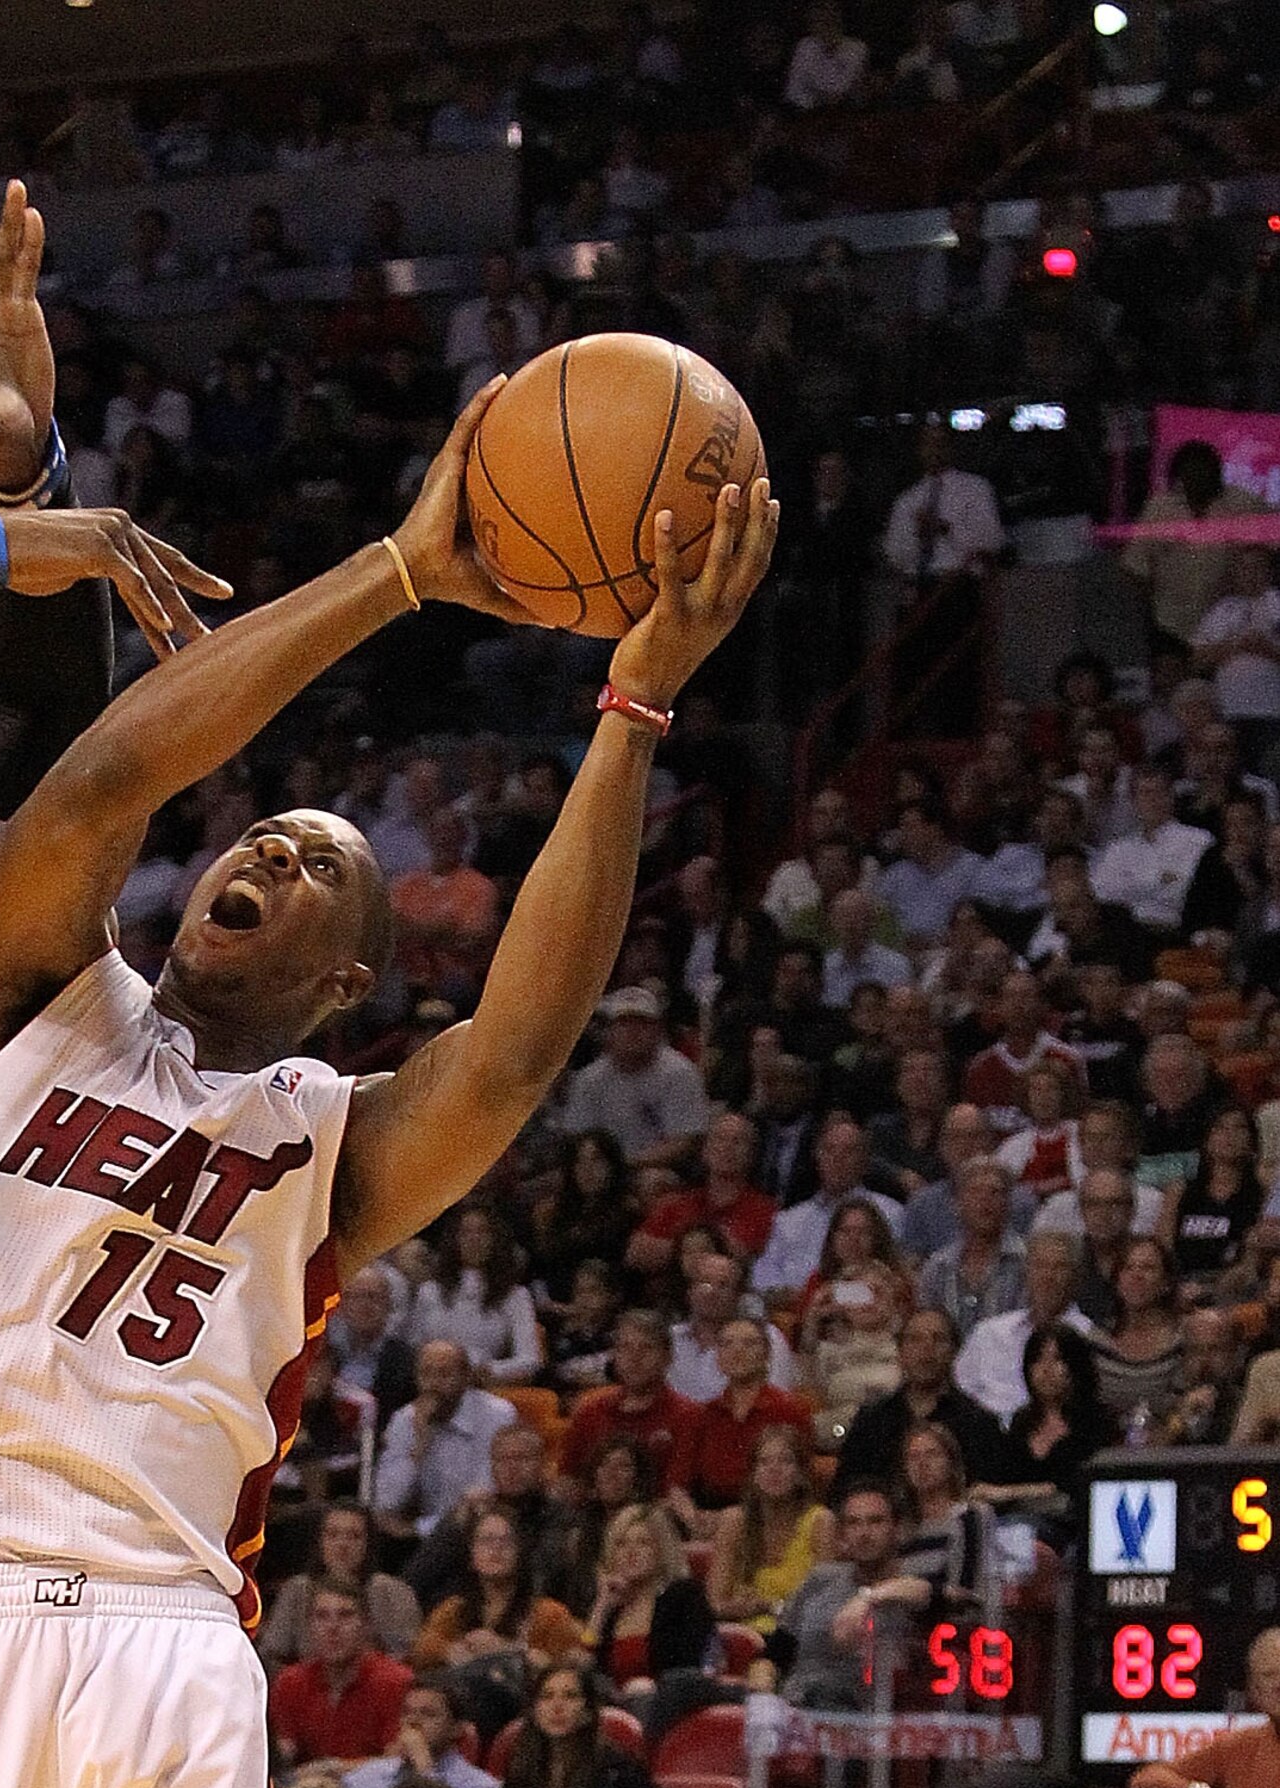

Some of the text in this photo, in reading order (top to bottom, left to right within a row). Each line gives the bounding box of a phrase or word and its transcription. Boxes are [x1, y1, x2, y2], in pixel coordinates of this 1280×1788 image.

[51, 1228, 228, 1369] 15
[1232, 1477, 1272, 1552] 5
[1112, 1623, 1204, 1699] 82
